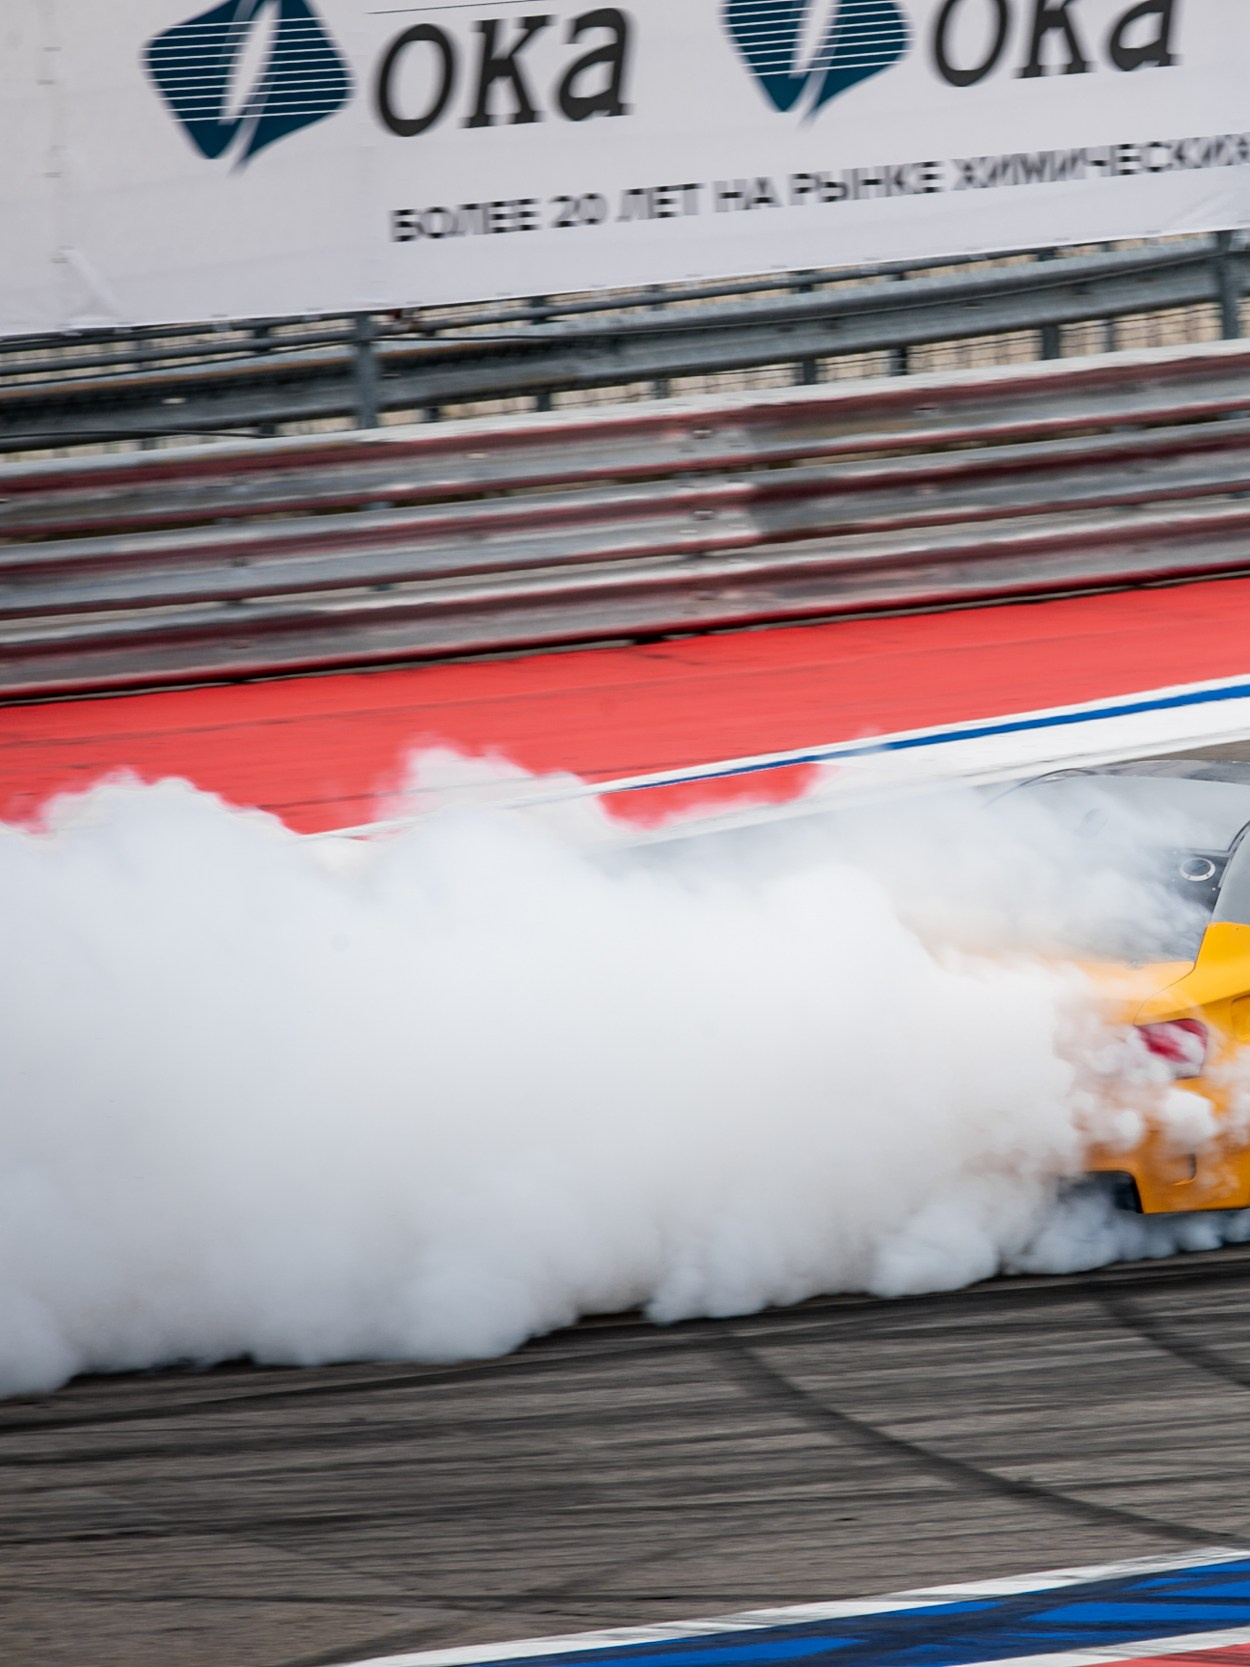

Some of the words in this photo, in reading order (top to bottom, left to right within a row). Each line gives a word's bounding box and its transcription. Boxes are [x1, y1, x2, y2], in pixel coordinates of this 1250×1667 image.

[372, 8, 637, 137] ока
[390, 198, 541, 242] БОЛЕЕ
[548, 193, 609, 228] 20
[614, 182, 704, 223] ЛЕТ
[712, 176, 783, 213] НА
[788, 160, 943, 206] РЫНКЕ
